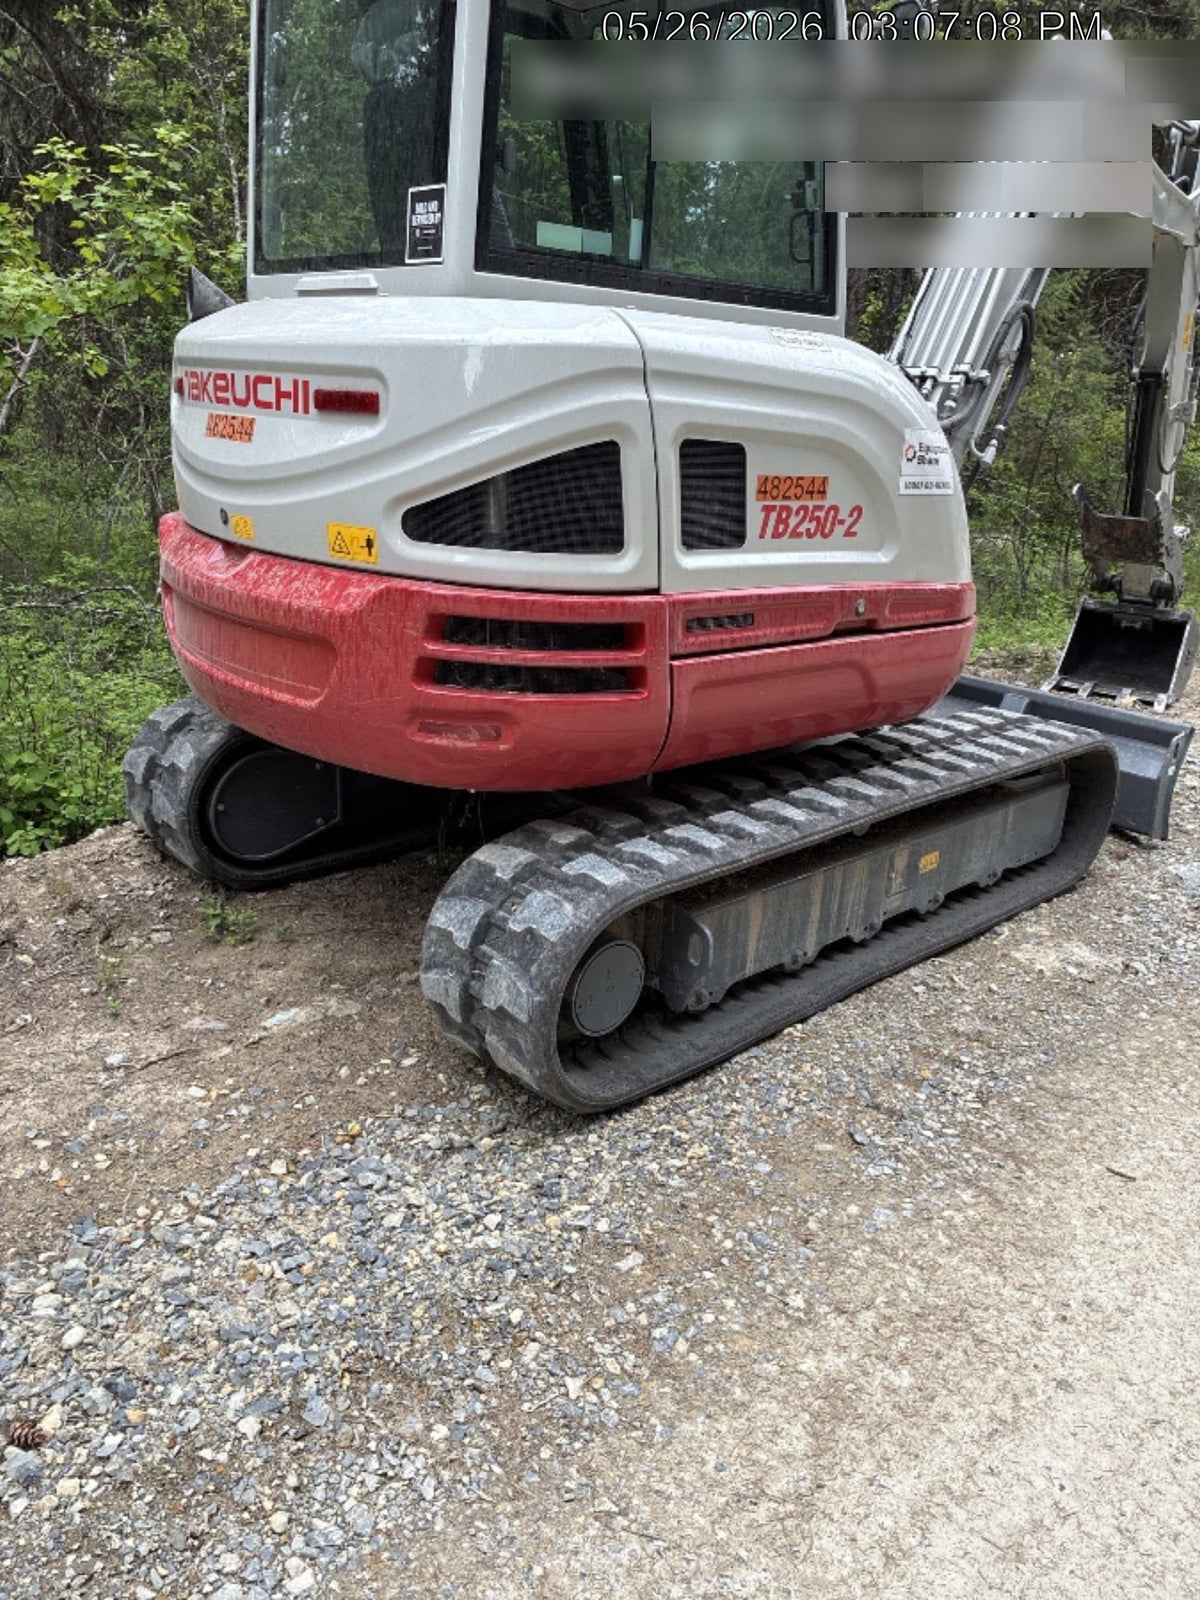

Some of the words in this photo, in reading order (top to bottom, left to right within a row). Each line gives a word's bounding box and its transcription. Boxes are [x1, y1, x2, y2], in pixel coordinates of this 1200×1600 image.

[205, 412, 256, 442] 482544
[757, 475, 828, 501] 482544
[758, 504, 864, 540] TB250-2
